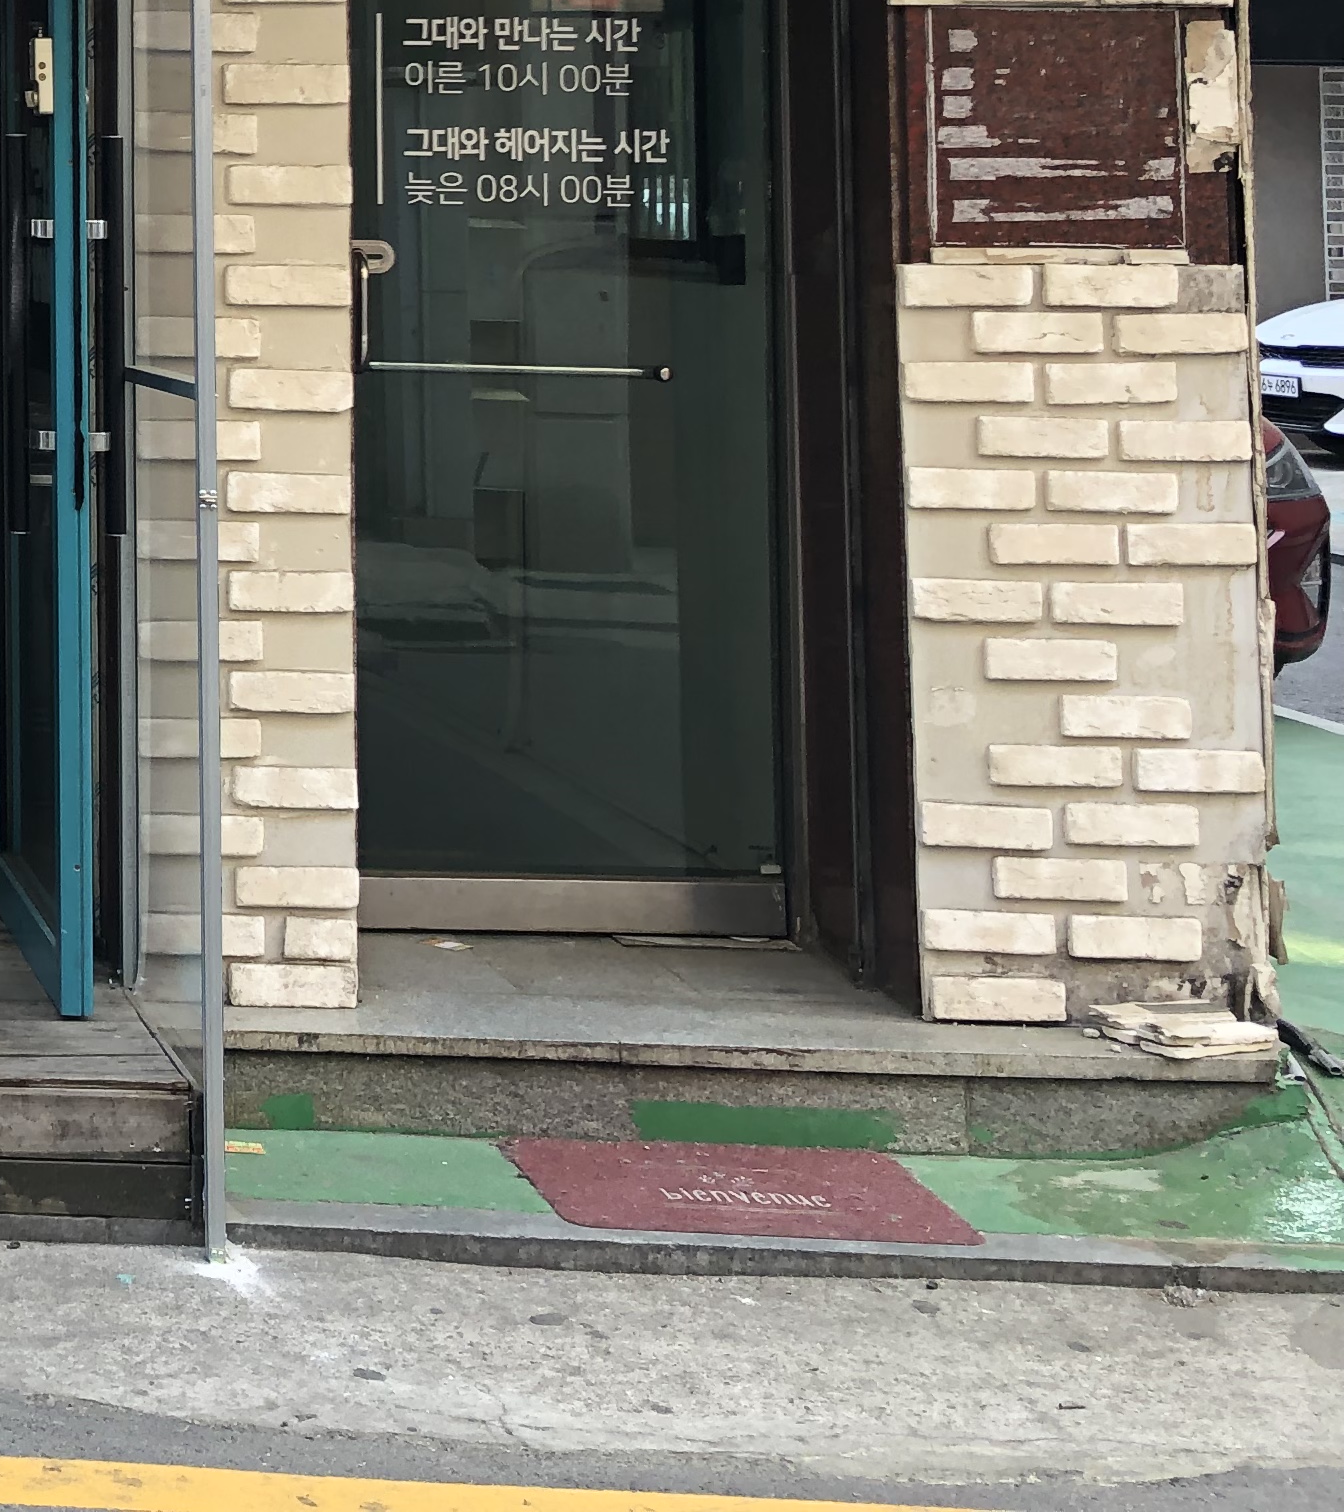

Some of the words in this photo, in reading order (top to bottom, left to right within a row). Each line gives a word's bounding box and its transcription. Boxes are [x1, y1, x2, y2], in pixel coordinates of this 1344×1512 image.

[402, 16, 488, 51] 그대와
[494, 16, 579, 52] 만나는
[584, 17, 643, 53] 시간
[404, 60, 467, 95] 이른
[477, 61, 549, 96] 10시
[559, 63, 634, 97] 00분
[402, 126, 489, 162] 그대와
[494, 126, 608, 164] 헤어지는
[613, 128, 670, 164] 시간
[404, 170, 468, 207] 늦은
[476, 172, 550, 207] 08시
[560, 173, 635, 208] 00분
[1275, 379, 1297, 395] 6896
